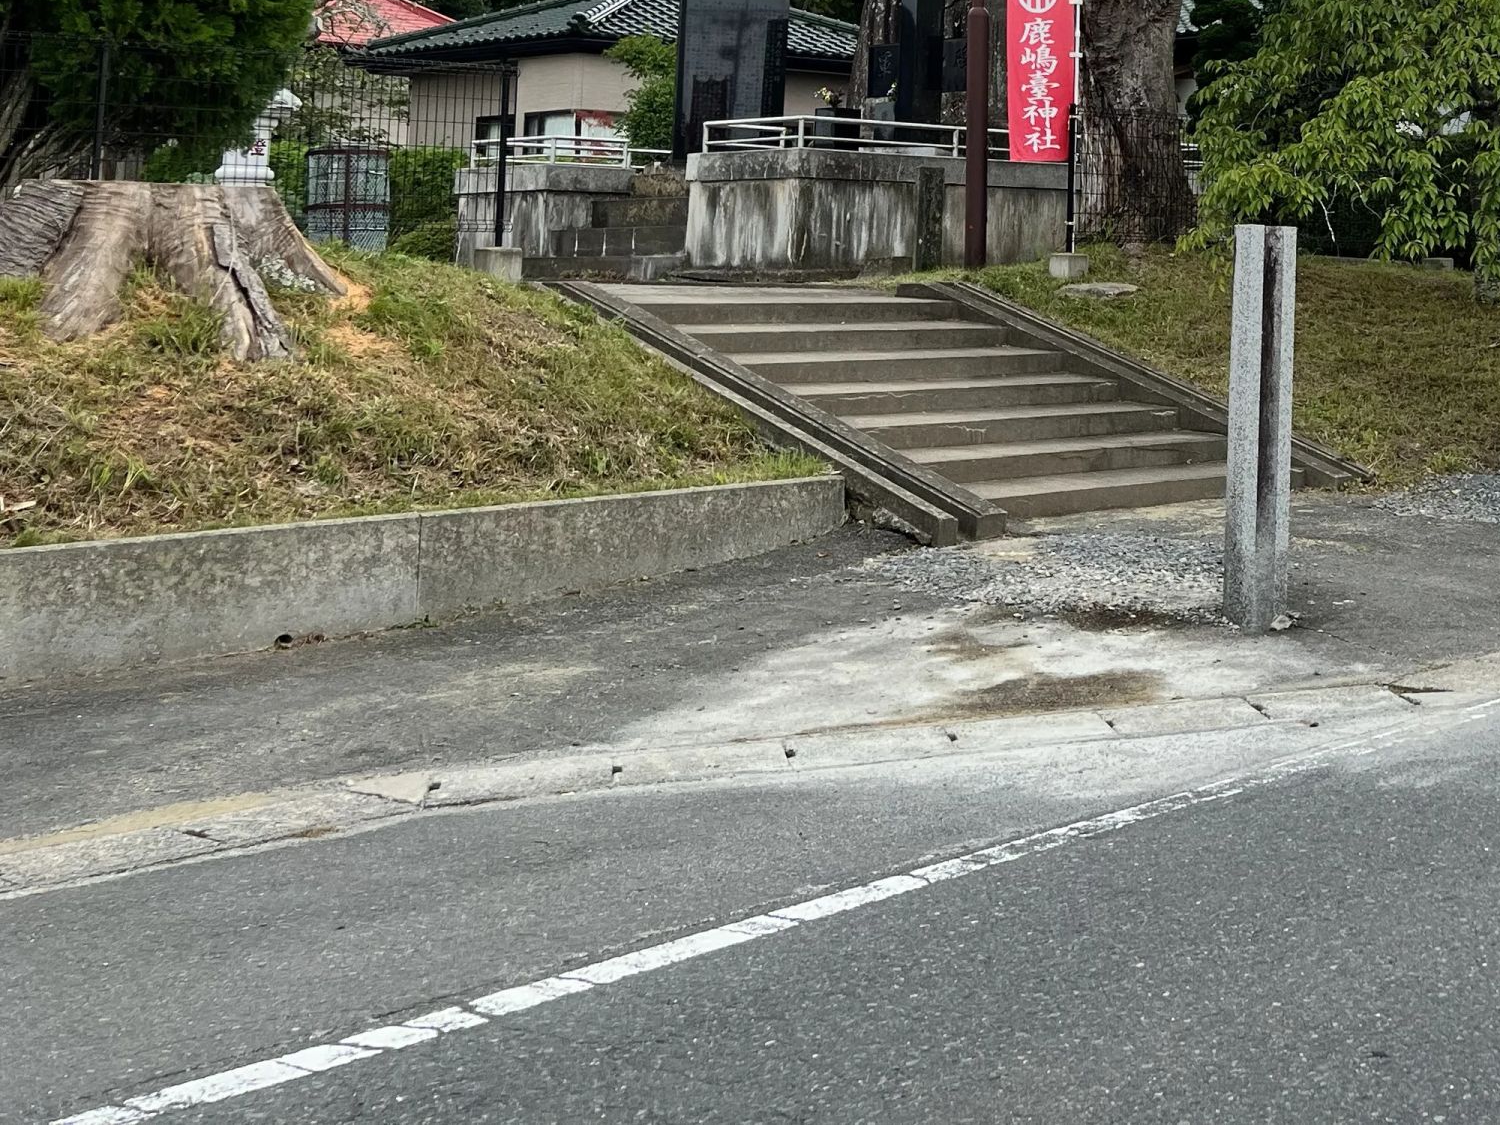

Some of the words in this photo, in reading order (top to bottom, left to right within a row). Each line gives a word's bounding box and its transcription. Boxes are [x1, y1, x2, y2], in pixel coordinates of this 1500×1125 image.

[1019, 17, 1061, 154] 鹿嶋臺神社
